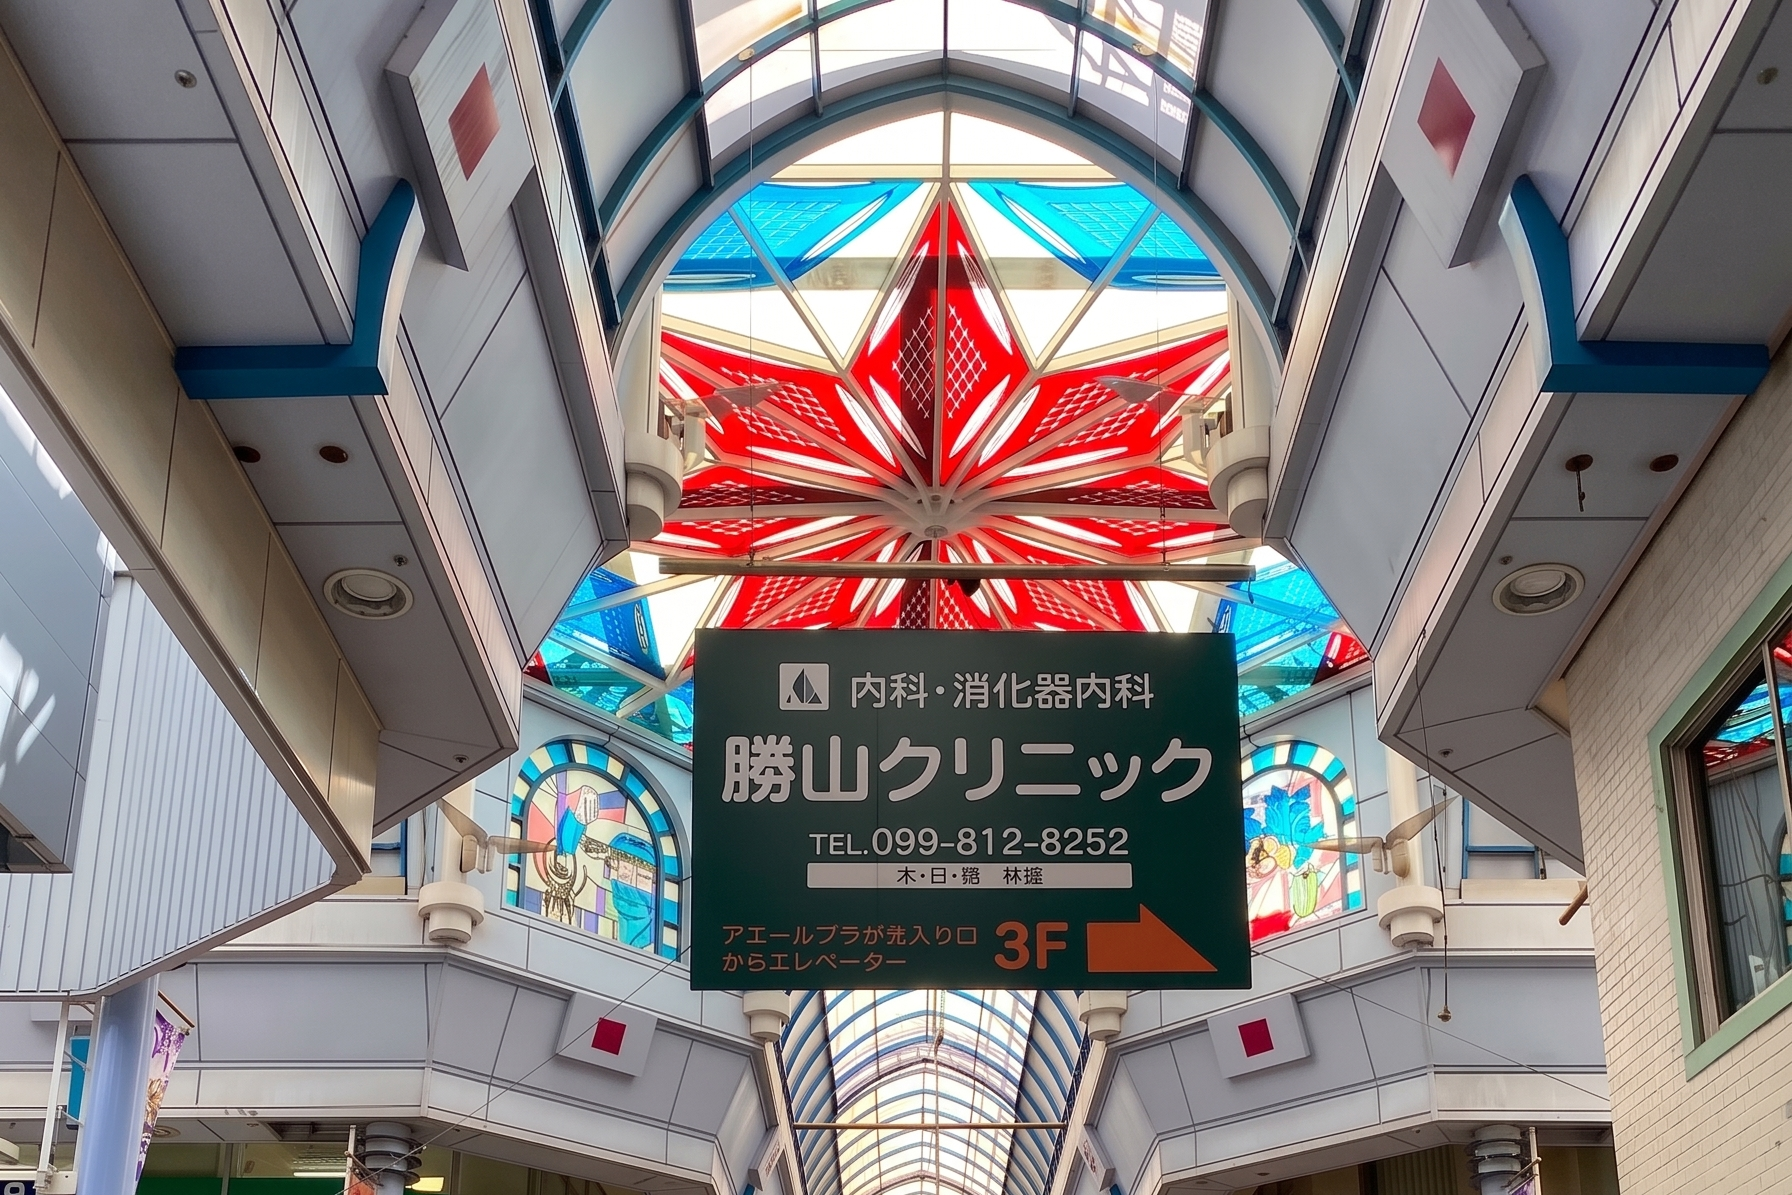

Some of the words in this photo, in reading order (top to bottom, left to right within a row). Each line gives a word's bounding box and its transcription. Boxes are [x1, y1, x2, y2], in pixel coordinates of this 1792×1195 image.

[851, 671, 1155, 709] 内科・消化器内科
[721, 734, 1213, 803] 勝山クリニック
[994, 921, 1069, 970] 3F
